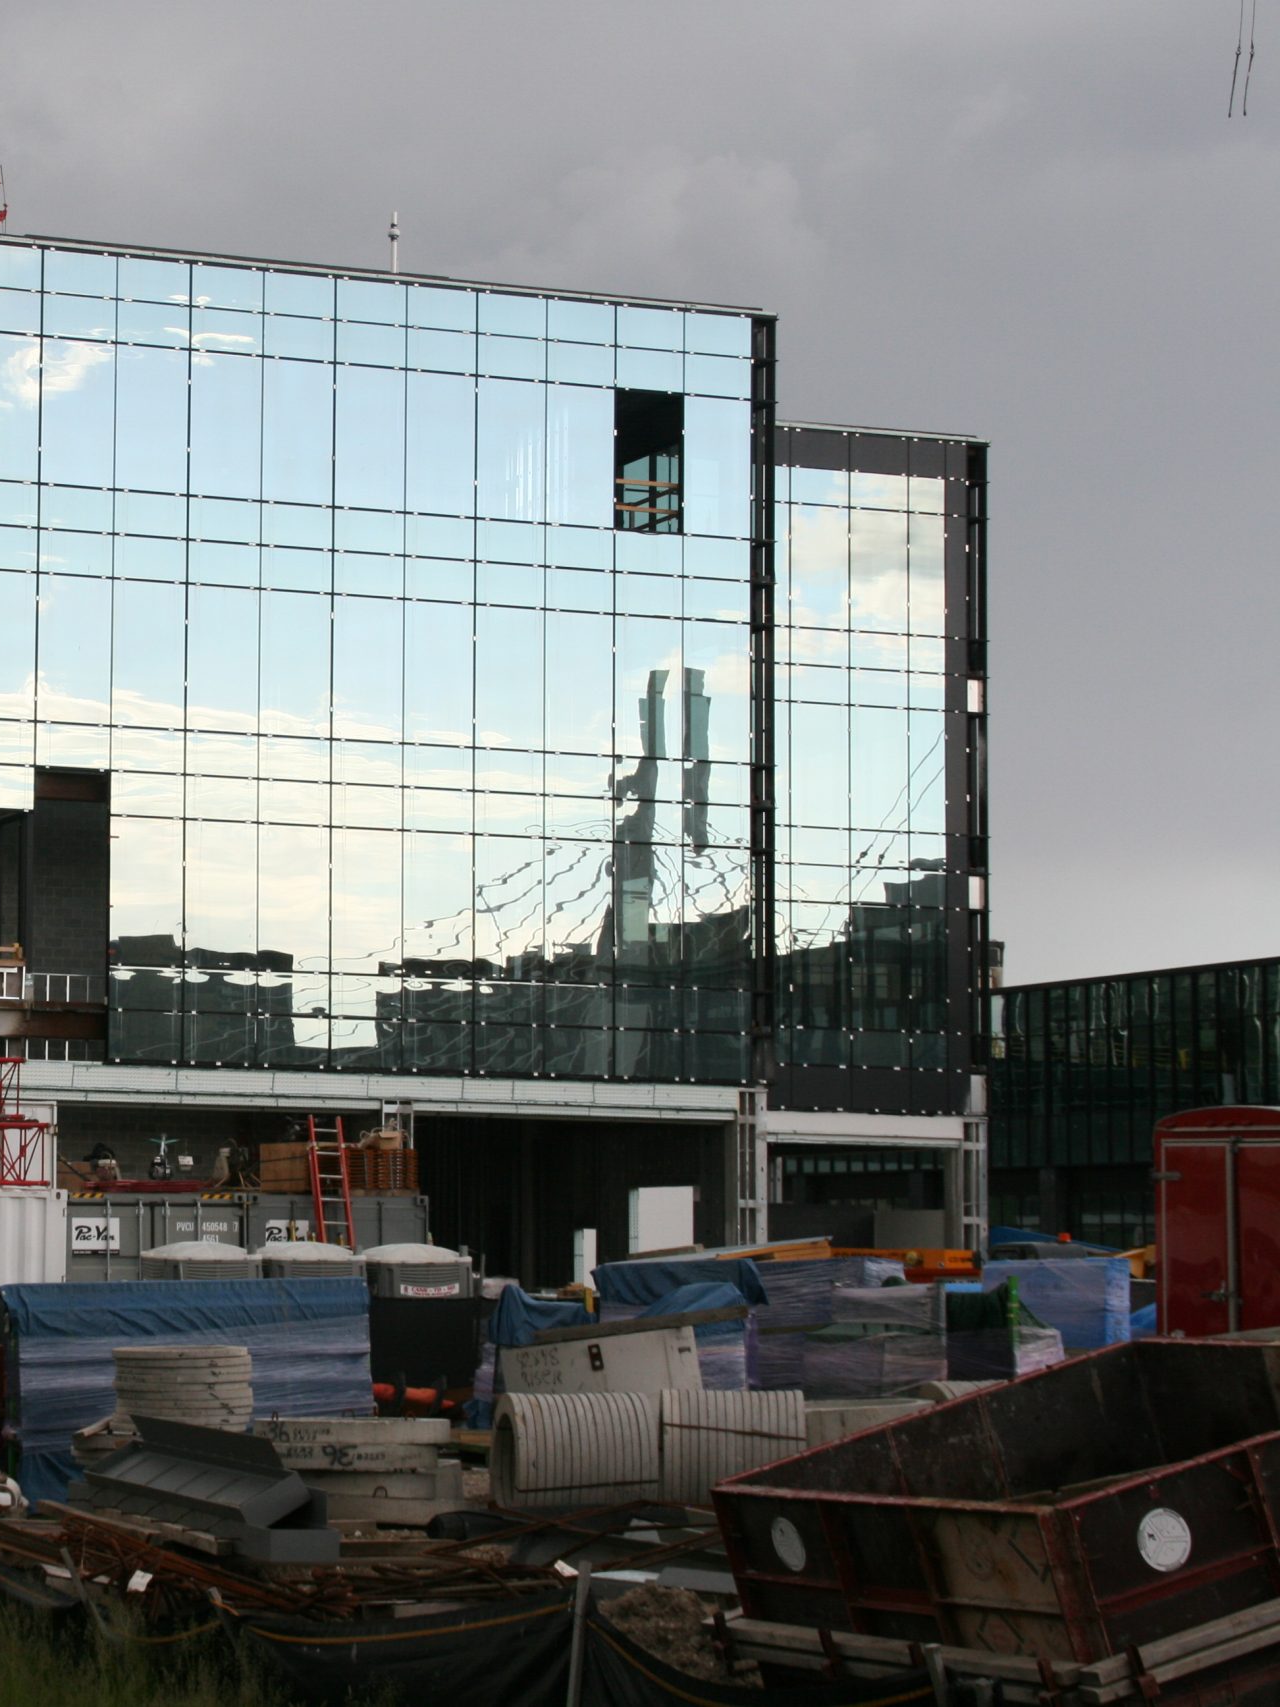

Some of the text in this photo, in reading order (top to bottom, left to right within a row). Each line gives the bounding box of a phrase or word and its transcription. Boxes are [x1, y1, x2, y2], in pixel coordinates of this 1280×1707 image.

[74, 1225, 115, 1241] Pac-Van
[176, 1221, 194, 1232] PVCU
[266, 1226, 305, 1242] Pac-Vn
